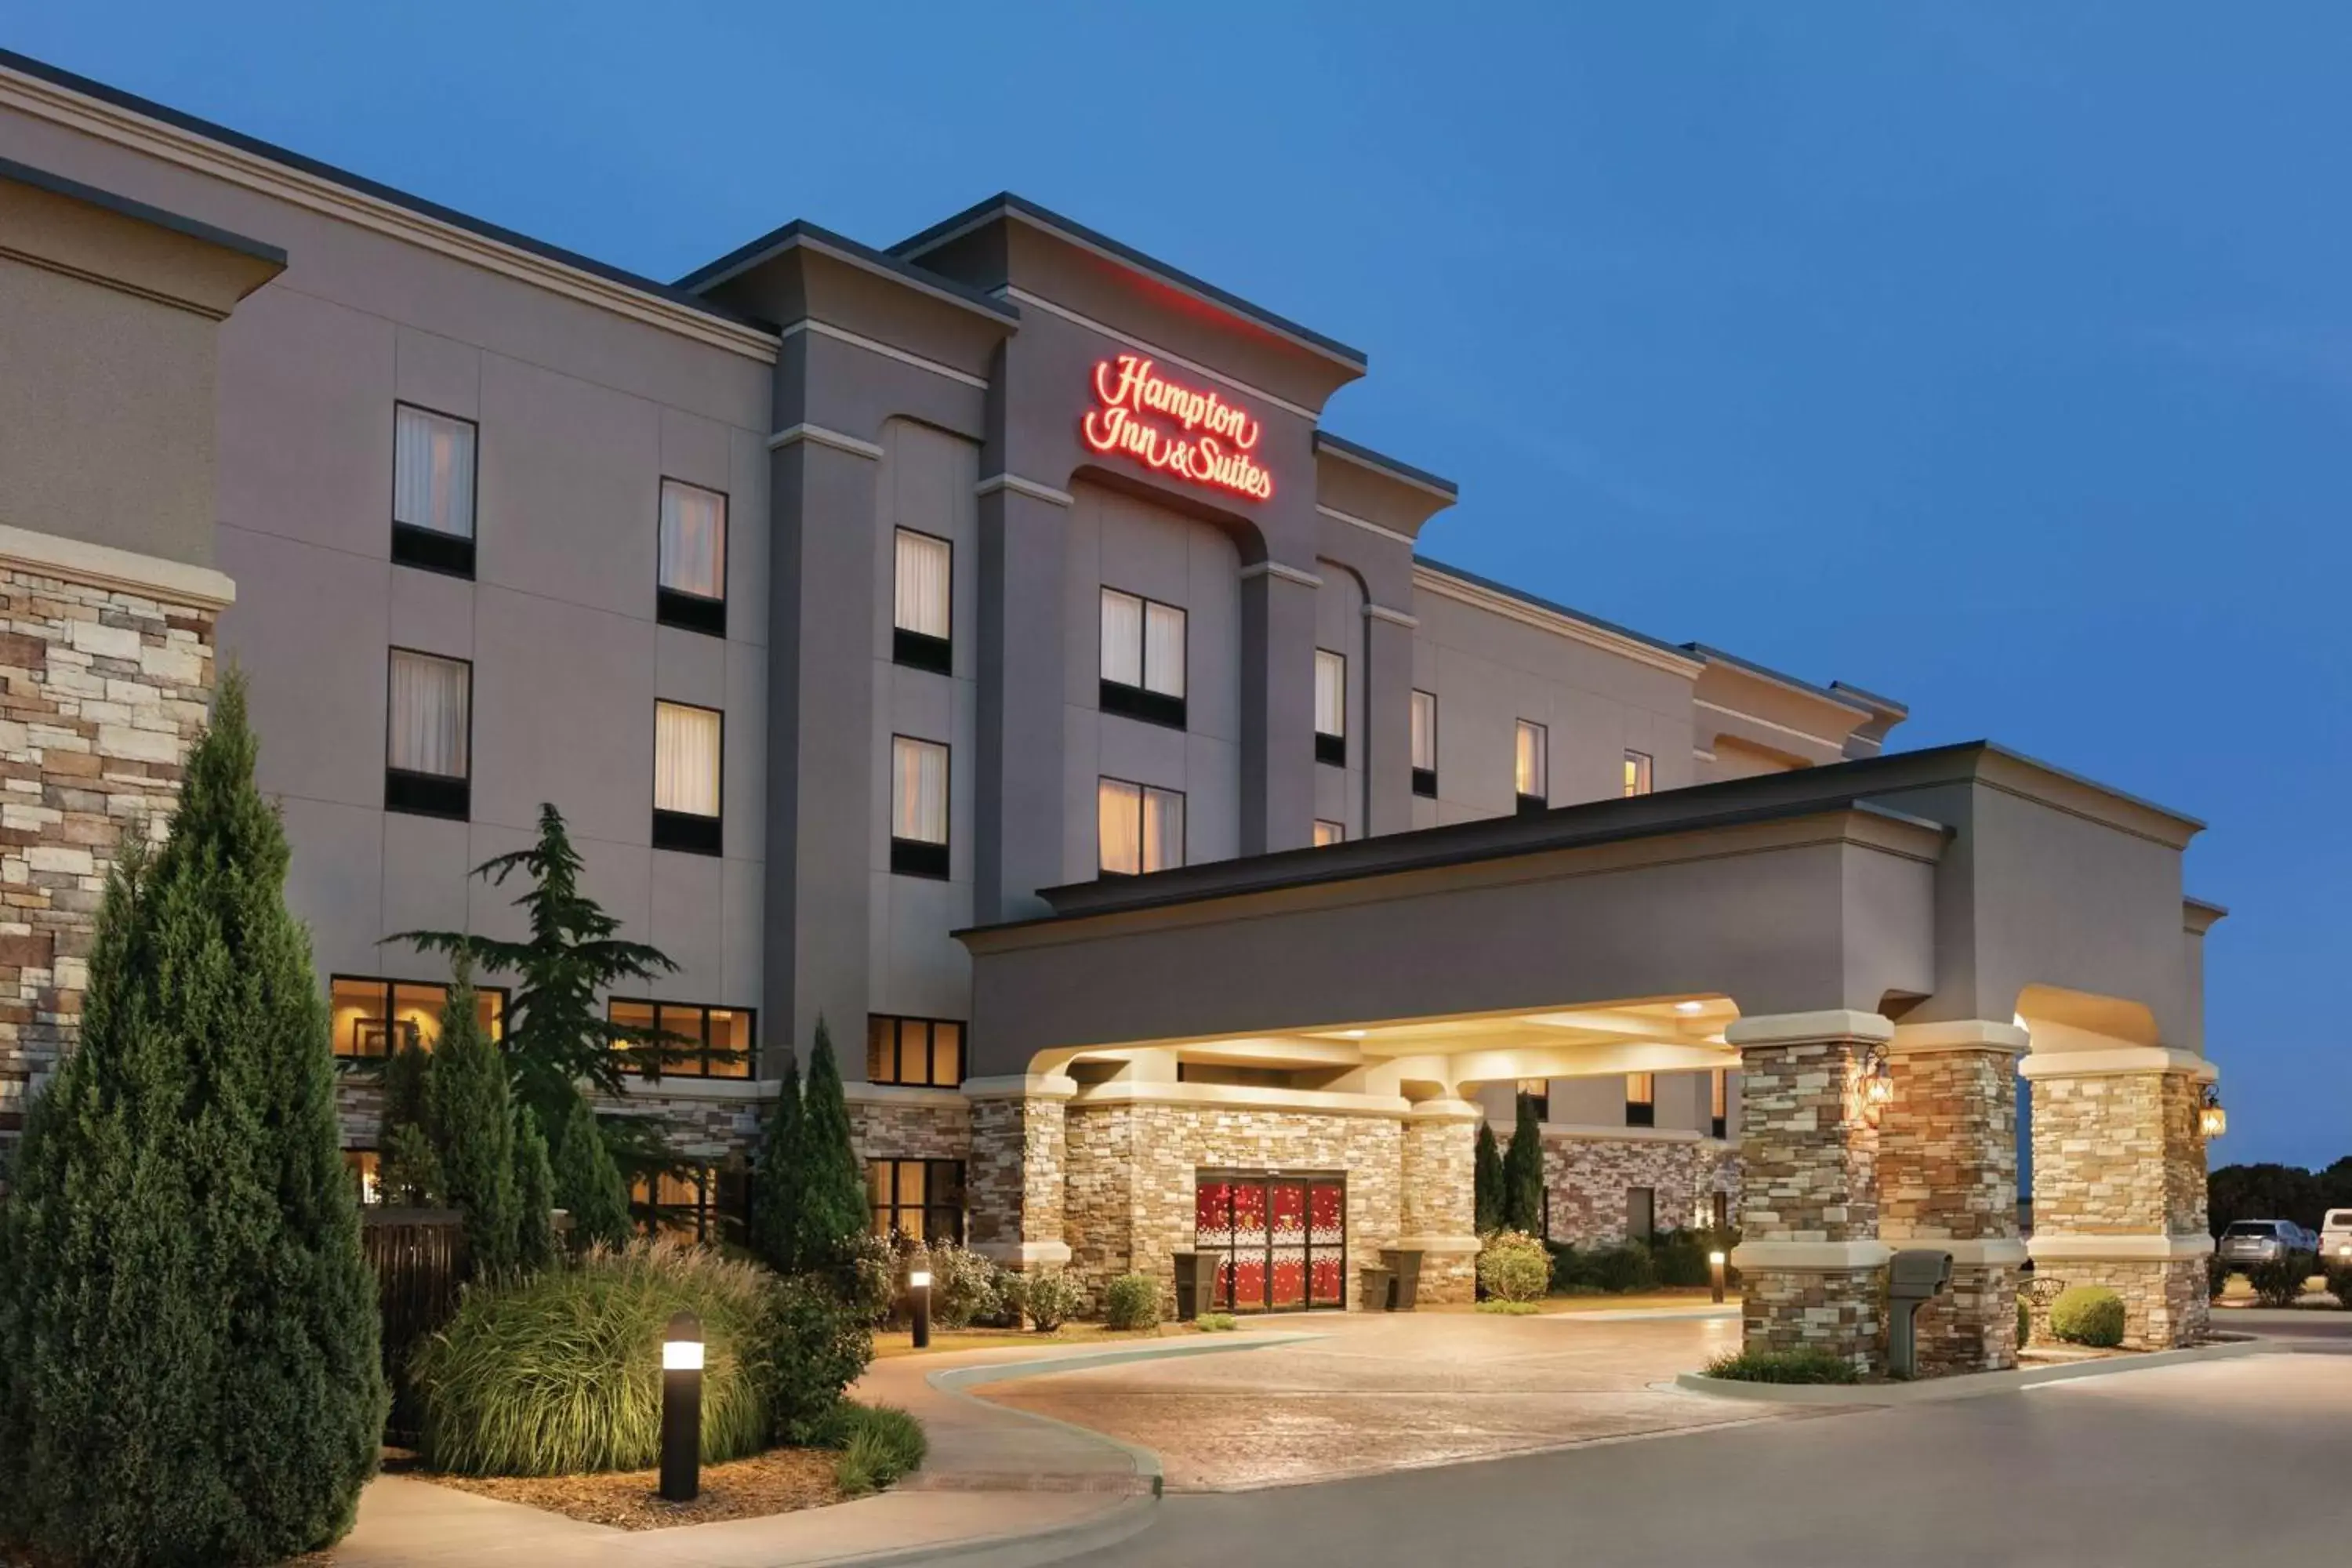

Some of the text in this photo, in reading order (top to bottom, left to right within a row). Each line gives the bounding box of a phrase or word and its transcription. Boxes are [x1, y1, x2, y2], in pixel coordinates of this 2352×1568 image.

[1095, 354, 1260, 450] Hampton
[1084, 406, 1272, 499] Inn & Suites
